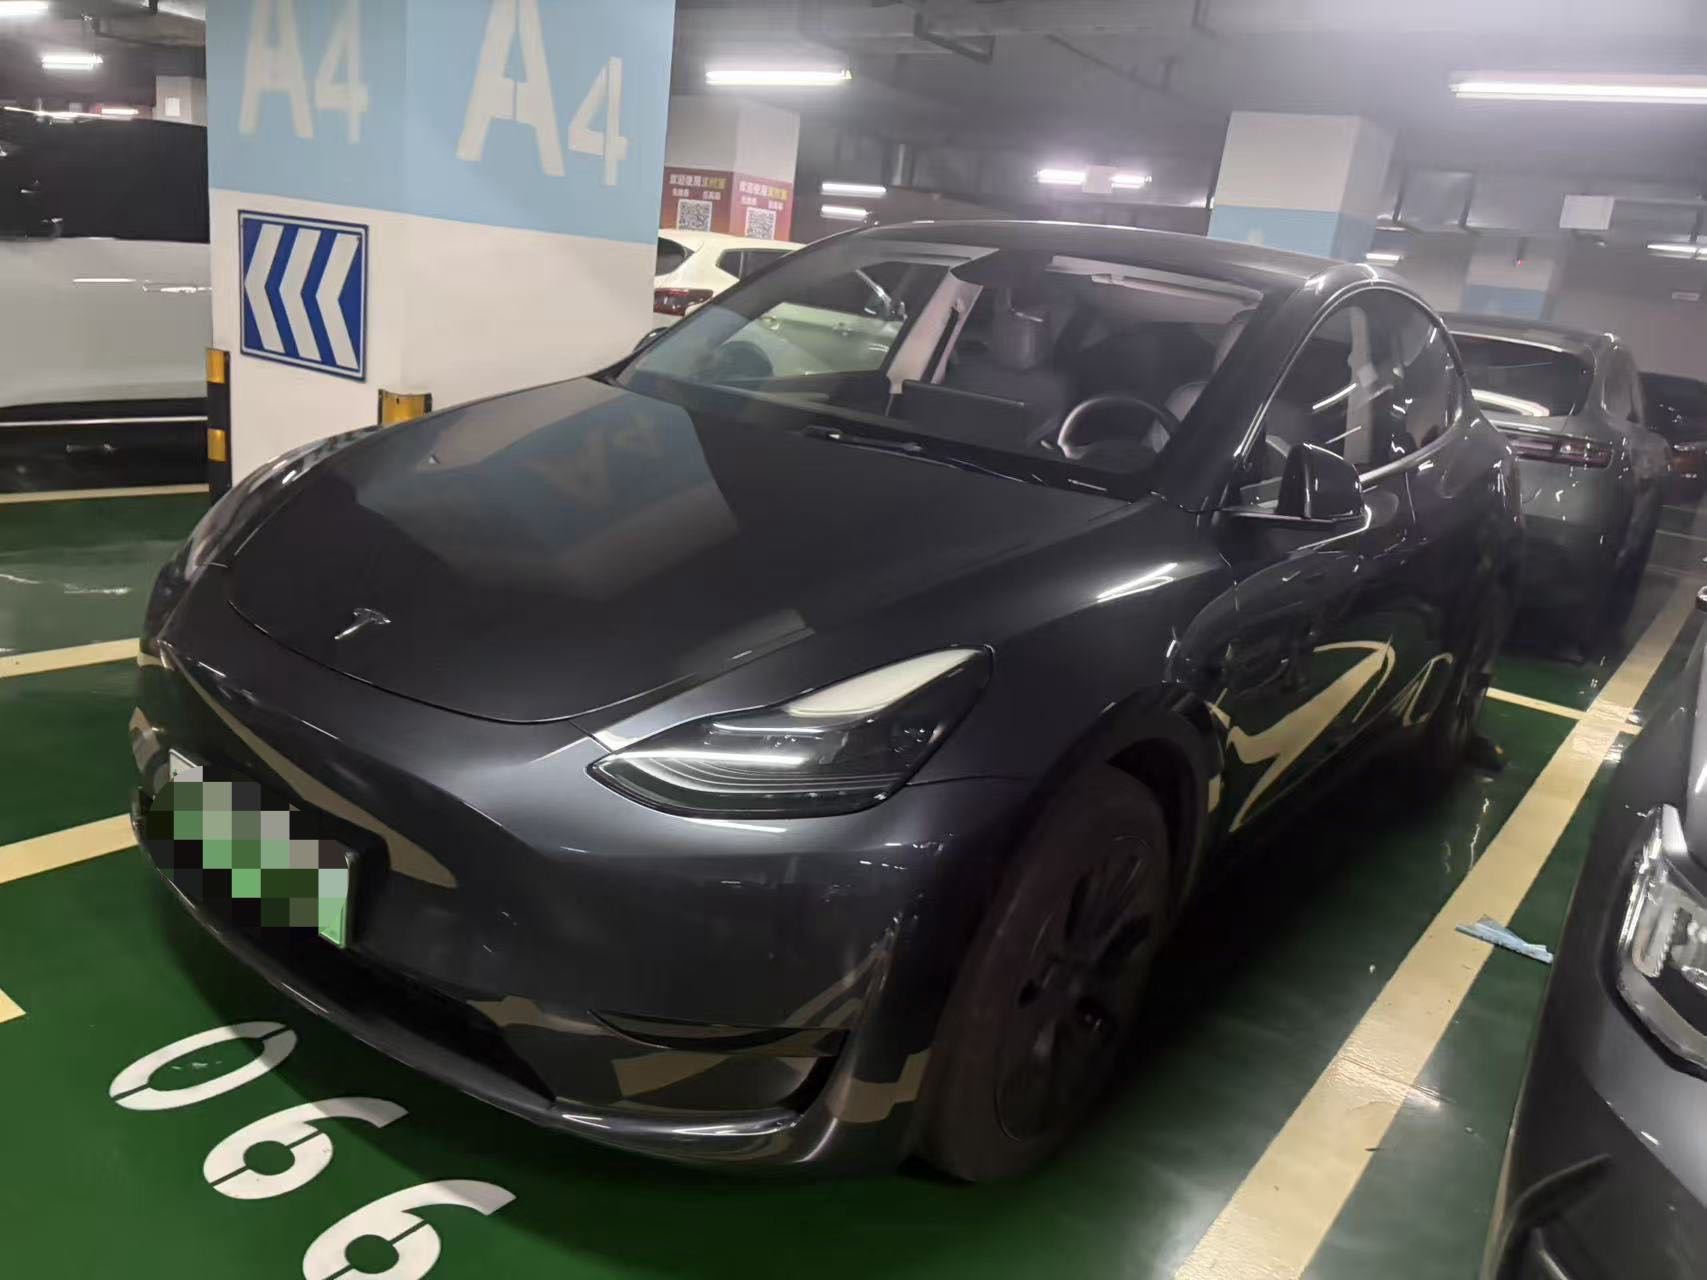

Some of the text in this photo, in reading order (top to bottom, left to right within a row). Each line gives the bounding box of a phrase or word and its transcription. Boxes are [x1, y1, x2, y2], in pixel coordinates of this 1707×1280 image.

[239, 0, 368, 143] A4
[457, 0, 627, 186] A4
[109, 1021, 517, 1280] 066
